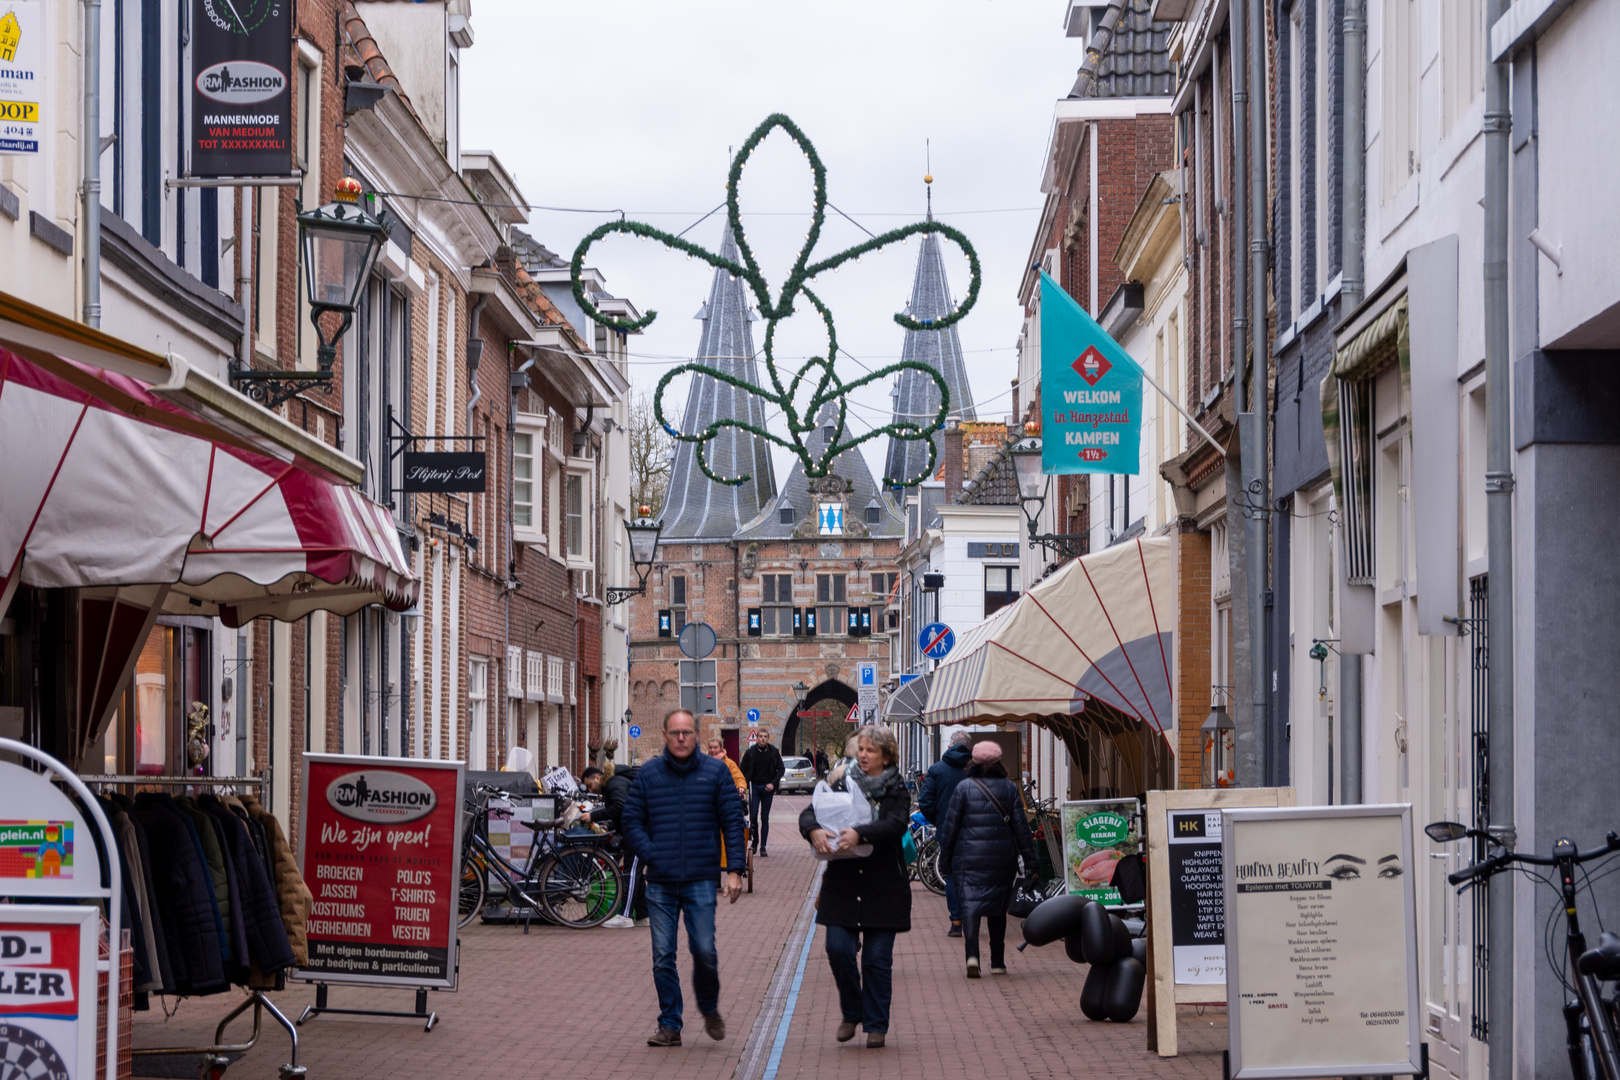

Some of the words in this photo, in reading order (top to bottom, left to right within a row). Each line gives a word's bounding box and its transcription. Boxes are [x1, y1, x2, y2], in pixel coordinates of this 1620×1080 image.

[204, 77, 221, 88] RM
[228, 77, 282, 88] FASHION
[204, 115, 280, 125] MANNENMODE
[209, 128, 230, 136] VAN
[232, 128, 274, 136] MEDIUM
[199, 140, 218, 149] TOT
[1063, 390, 1120, 404] WELKOM
[1054, 410, 1068, 423] in
[1069, 408, 1130, 429] Hanzestad
[1066, 432, 1120, 445] KAMPEN
[406, 466, 453, 483] Slijterij
[454, 466, 482, 480] Post
[864, 669, 870, 678] P
[335, 788, 357, 802] RM
[366, 790, 431, 805] FASHION
[1082, 816, 1122, 829] SLAGERIJ
[1180, 821, 1199, 831] HK
[321, 820, 348, 844] We
[351, 826, 381, 852] zijn
[386, 824, 431, 851] open!
[336, 853, 364, 861] BINNEN
[369, 855, 389, 863] VOOR
[407, 857, 440, 866] MOOISTE
[1182, 858, 1222, 866] HIGHLIGHTS
[317, 865, 363, 881] BROEKEN
[1185, 866, 1219, 874] BALAYAGE
[1277, 859, 1319, 879] BEAUTY
[397, 870, 431, 885] POLO'S
[320, 884, 357, 899] JASSEN
[1245, 884, 1273, 892] Epileren
[391, 888, 436, 904] T-SHIRTS
[311, 902, 365, 918] KOSTUUMS
[394, 906, 430, 922] TRUIEN
[392, 924, 430, 940] VESTEN
[317, 944, 334, 954] Met
[337, 946, 362, 957] eigen
[365, 947, 428, 960] borduurstudio
[327, 958, 369, 970] bedrijven
[372, 961, 379, 970] &
[382, 962, 440, 974] particulieren
